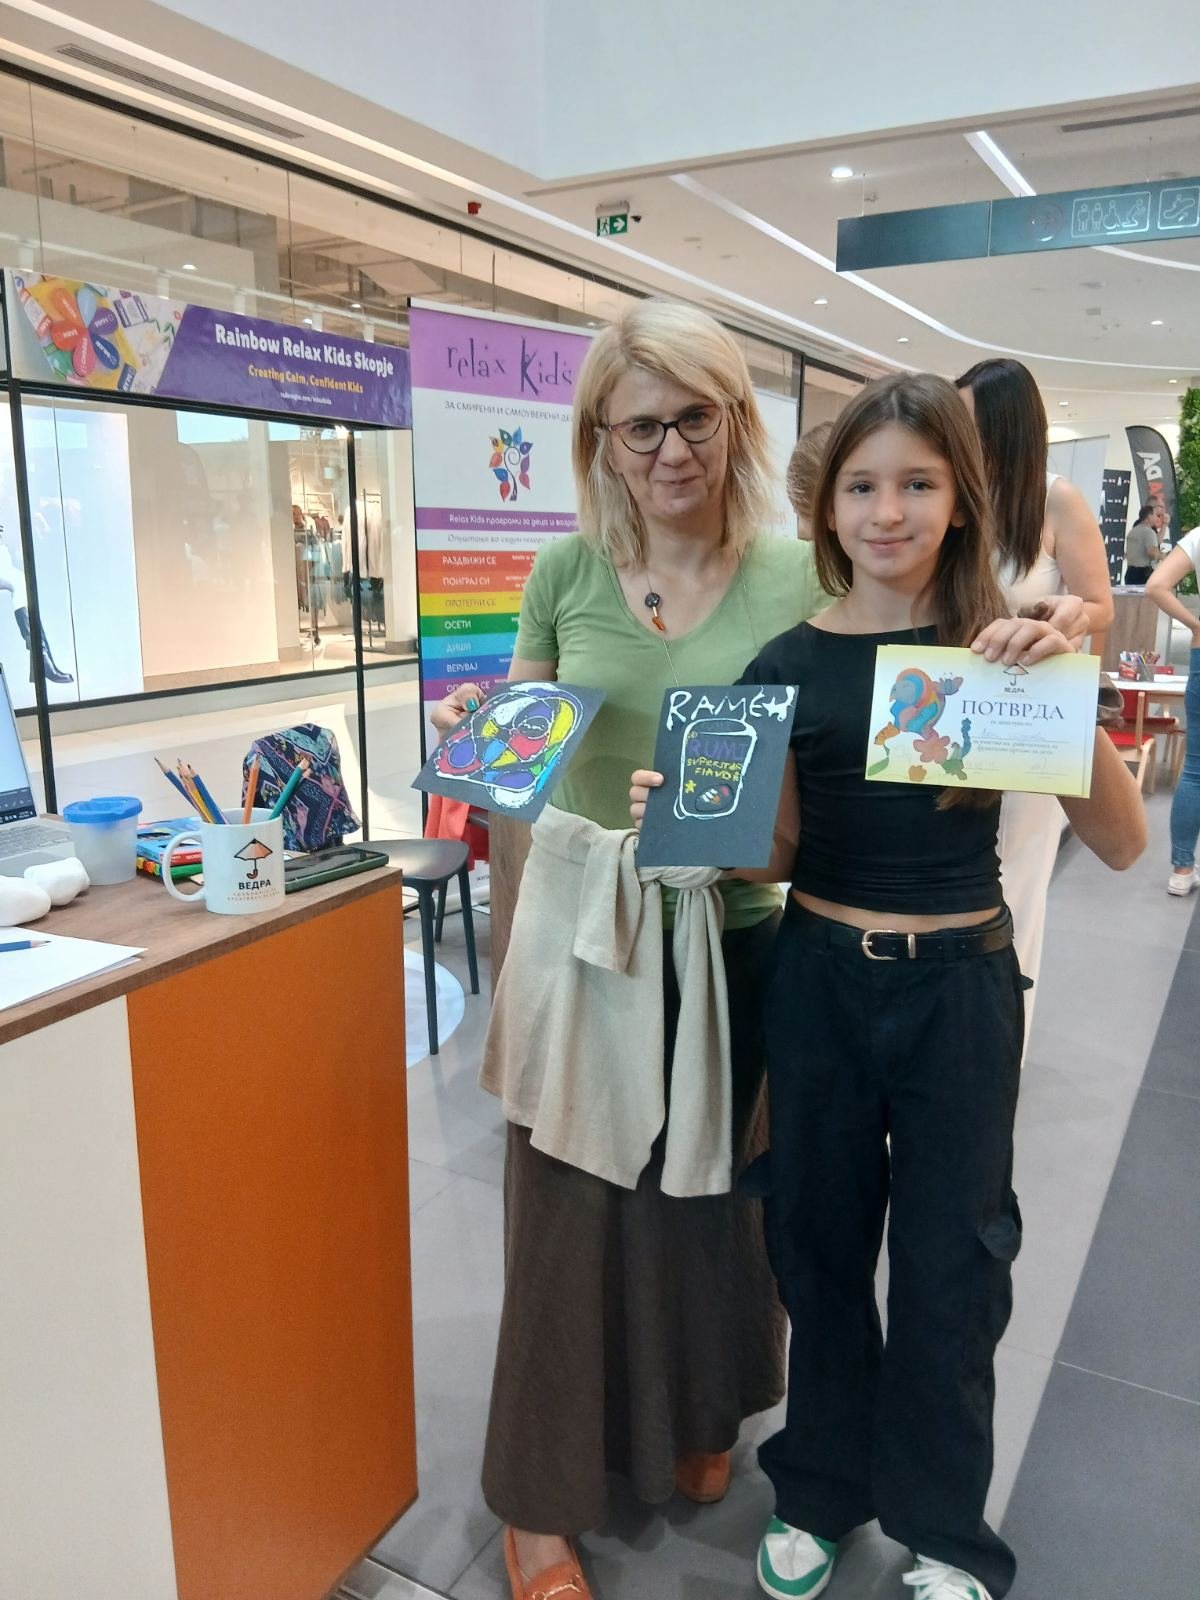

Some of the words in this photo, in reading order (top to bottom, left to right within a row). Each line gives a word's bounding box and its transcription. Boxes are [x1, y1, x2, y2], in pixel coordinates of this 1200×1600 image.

[215, 323, 280, 355] Rainbow
[283, 336, 321, 362] Relax
[323, 344, 352, 368] Kids
[354, 351, 394, 378] Skopje
[447, 338, 506, 378] relax
[520, 335, 573, 396] Kids
[248, 364, 285, 384] Creating
[309, 374, 347, 392] Confident
[347, 380, 364, 394] Kids
[445, 401, 455, 409] ЗА
[449, 514, 468, 524] Relax
[470, 515, 485, 525] Kids
[442, 555, 485, 566] РАЗДВИЖИ
[486, 556, 497, 565] СЕ
[442, 576, 478, 586] ПОИГРАЈ
[479, 577, 490, 586] СИ
[444, 620, 472, 630] ОСЕТИ
[446, 642, 472, 653] ДИШИ
[446, 662, 478, 673] ВЕРУВАЈ
[962, 699, 1065, 721] ПОТВРДА
[238, 879, 271, 891] ВЕДРА
